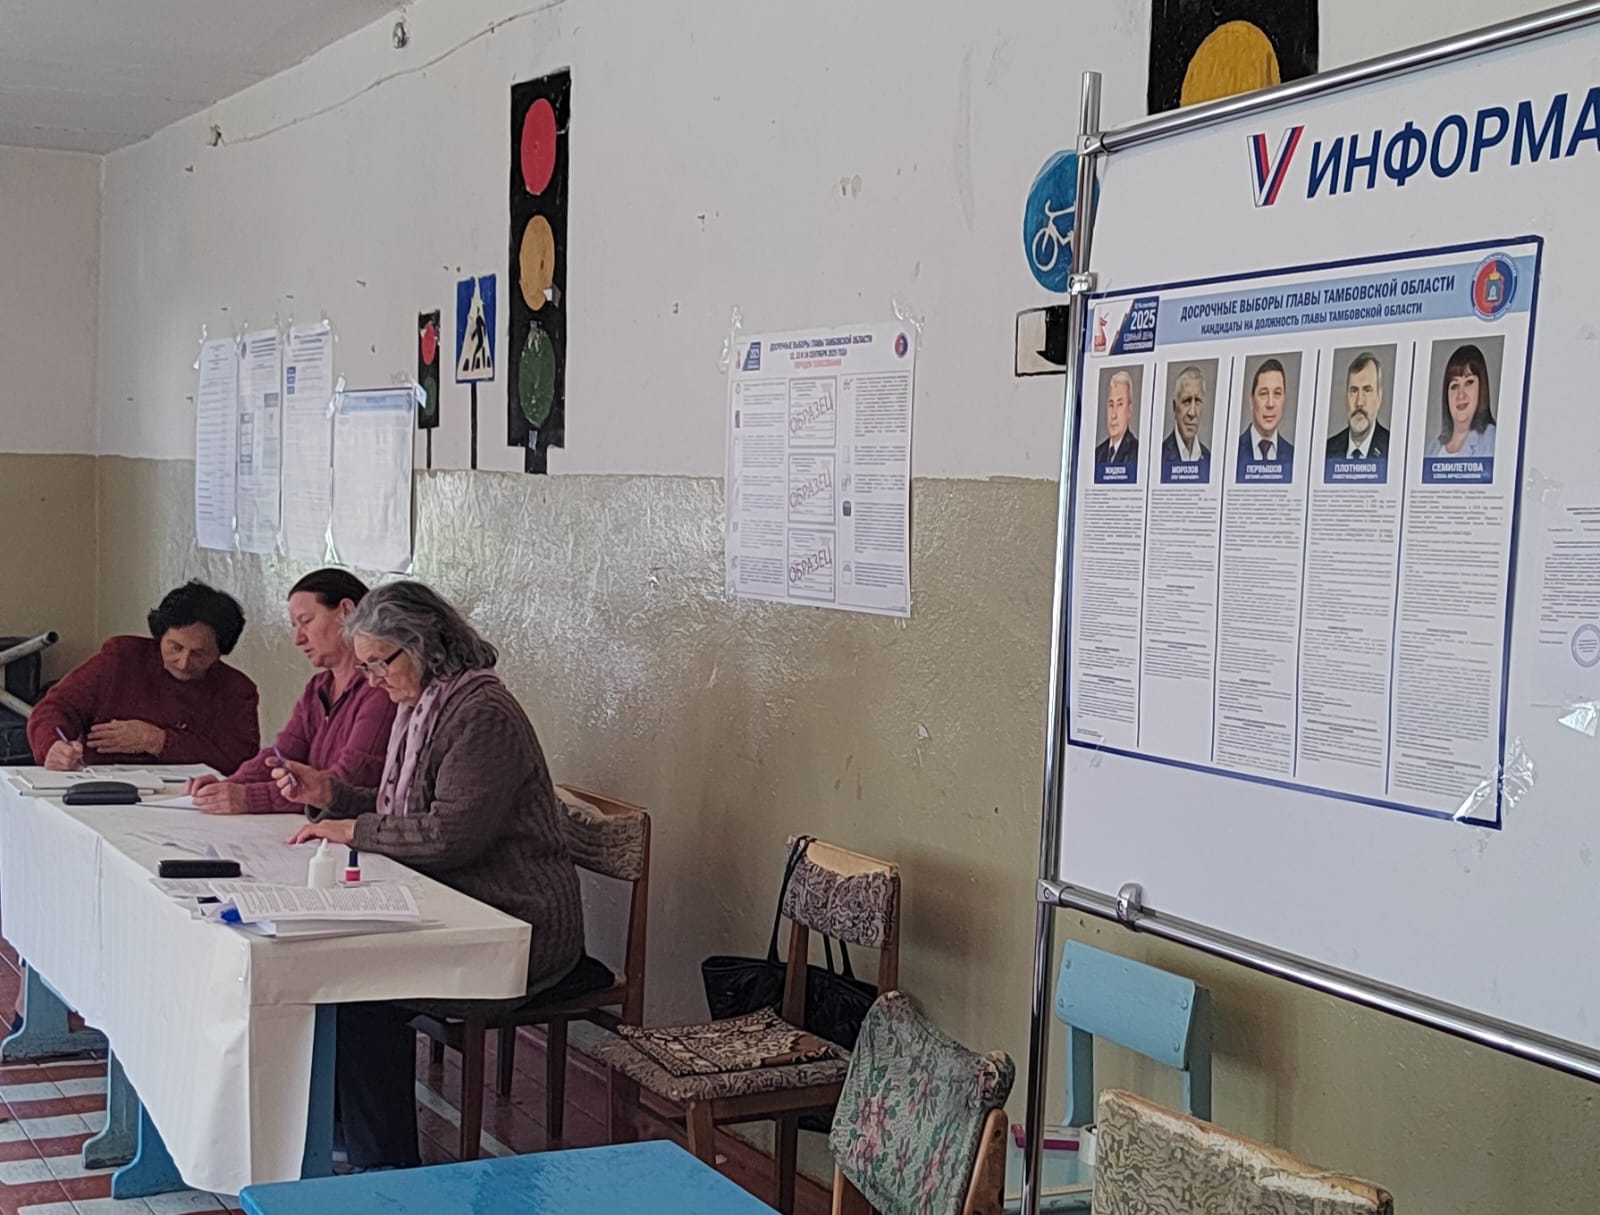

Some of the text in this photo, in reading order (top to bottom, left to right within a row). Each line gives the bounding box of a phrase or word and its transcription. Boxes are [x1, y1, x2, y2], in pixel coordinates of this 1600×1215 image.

[1306, 87, 1600, 199] ИНФОРМА
[1180, 275, 1455, 322] ДОСРОЧНЫЕ ВЫБОРЫ ГЛАВЫ ТАМБОВСКОЙ ОБЛАСТИ
[1130, 309, 1156, 330] 2025
[1200, 302, 1423, 335] КАНДИДАТЫ НА ДОЛЖНОСТЬ ГЛАВЫ ТАМБОВСКОЙ ОБЛАСТИ
[790, 392, 834, 434] ОБРАЗЕЦ
[1334, 463, 1377, 473] ПЛОТНИКОВ
[1431, 462, 1484, 473] СЕМИЛЕТОВА
[789, 469, 832, 509] ОБРАЗЕЦ
[789, 545, 833, 583] ОБРАЗЕЦ
